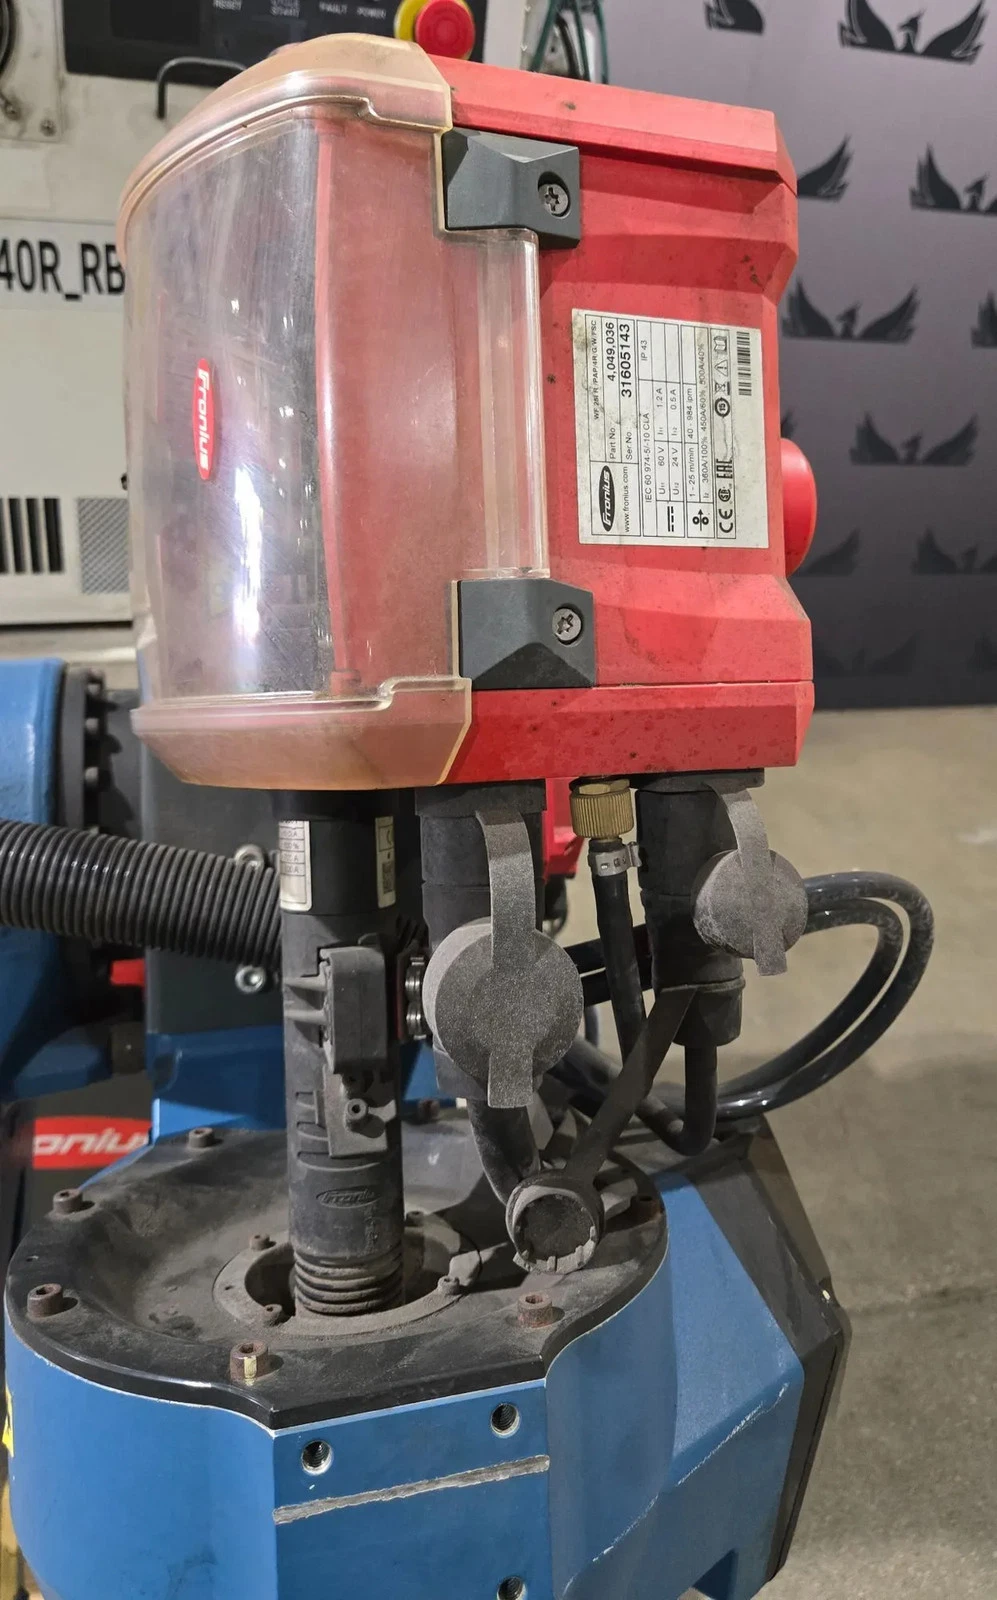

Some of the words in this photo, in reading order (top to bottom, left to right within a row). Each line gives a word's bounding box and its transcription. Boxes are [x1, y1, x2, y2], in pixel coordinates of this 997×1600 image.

[319, 2, 348, 14] FAULT
[640, 340, 647, 350] 43
[606, 322, 617, 381] 4,049,036
[641, 353, 647, 361] IP
[620, 324, 632, 398] 31605143
[594, 408, 599, 419] WF
[198, 368, 210, 471] Fronius
[687, 429, 693, 438] 40
[658, 456, 664, 466] 60
[672, 456, 678, 467] 24
[645, 475, 651, 485] 60
[689, 475, 695, 484] 25
[602, 470, 611, 526] Fronius
